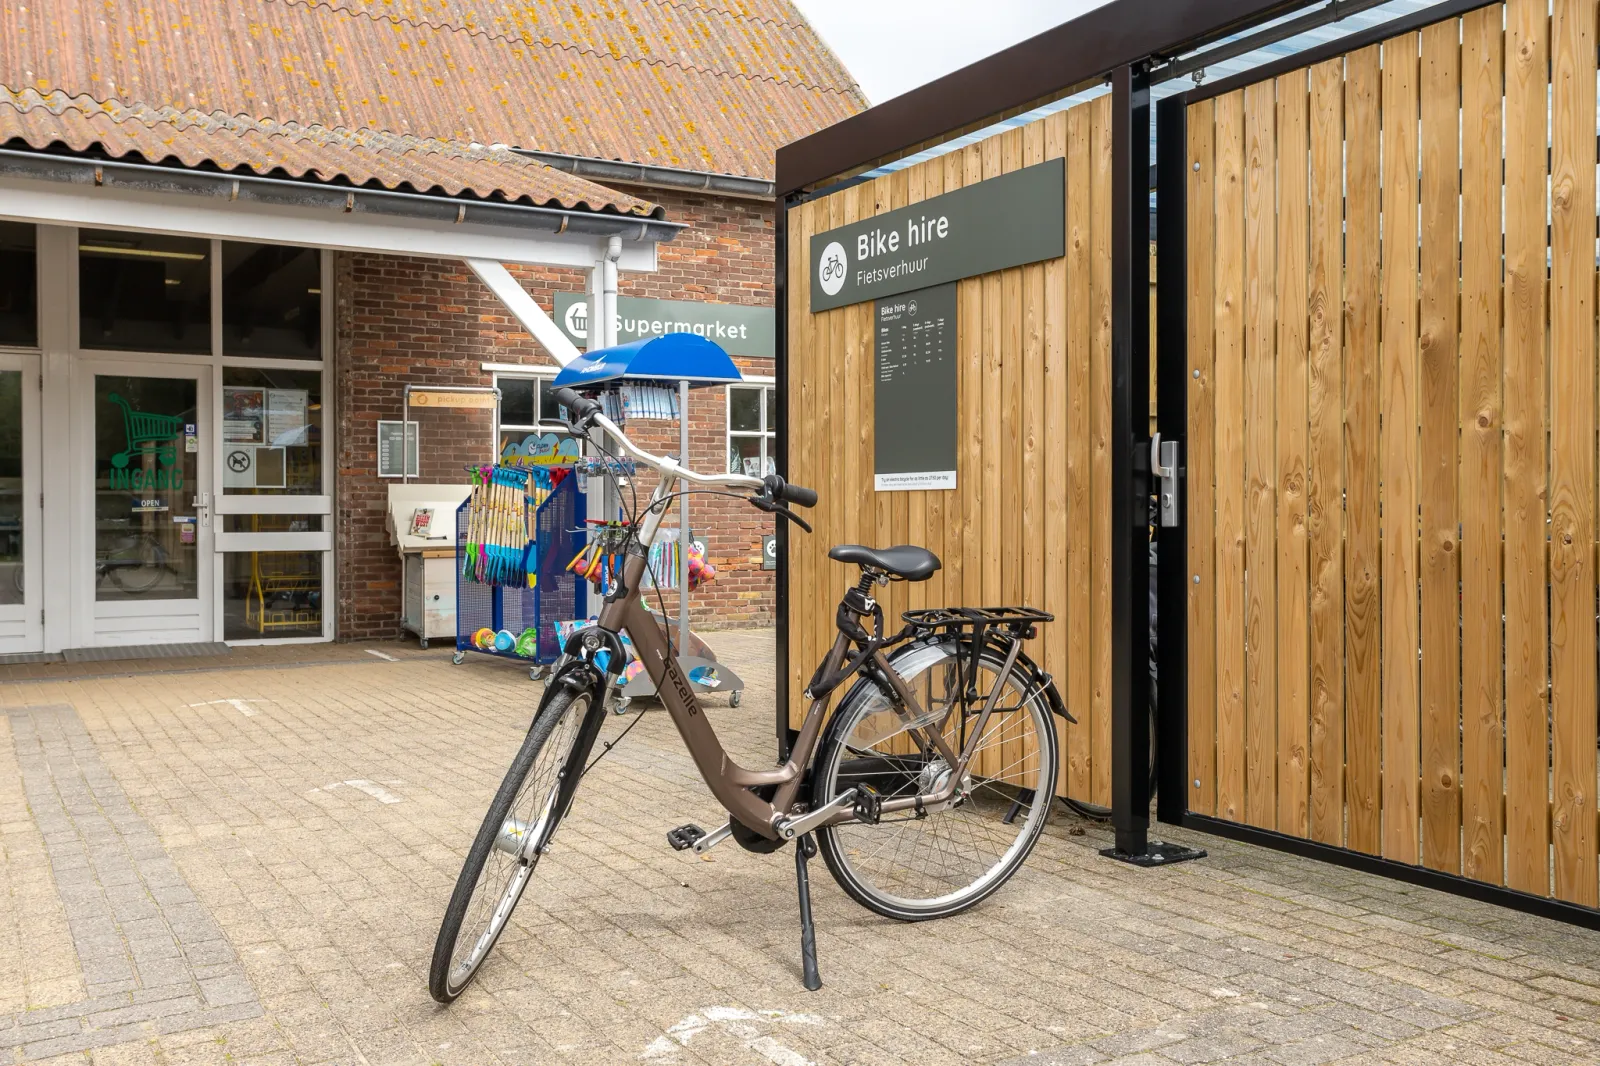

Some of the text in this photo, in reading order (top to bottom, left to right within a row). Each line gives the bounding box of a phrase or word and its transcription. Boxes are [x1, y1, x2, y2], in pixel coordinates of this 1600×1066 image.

[857, 216, 949, 261] Bike hire
[857, 257, 929, 286] Fietsverhuur
[881, 303, 906, 316] Bike hire
[141, 499, 160, 507] OPEN
[663, 658, 698, 717] Gazelle
